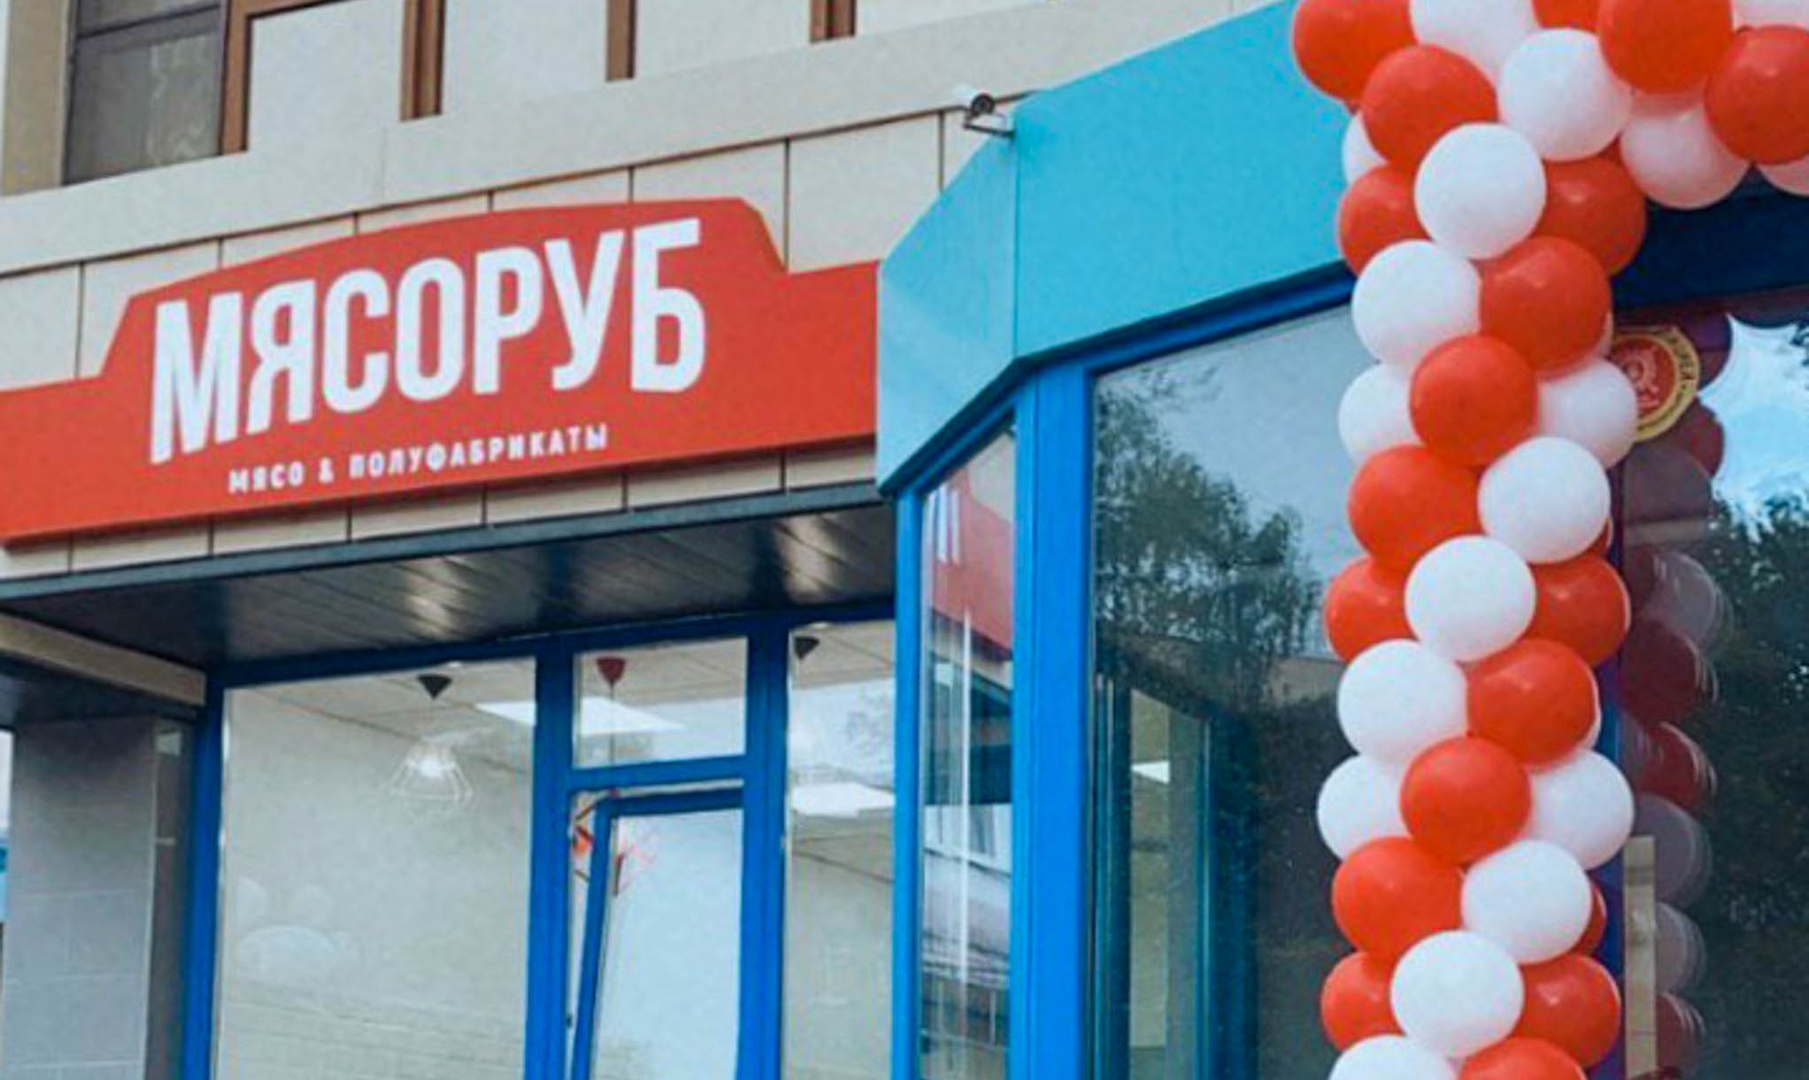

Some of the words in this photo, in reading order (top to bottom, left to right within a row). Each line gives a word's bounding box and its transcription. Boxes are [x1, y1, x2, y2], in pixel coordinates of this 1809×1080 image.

[150, 217, 705, 464] МЯСОРУБ
[228, 463, 304, 493] МЯСО
[319, 458, 335, 483] &
[350, 424, 608, 478] ПОЛУФАБРИКАТЫ
